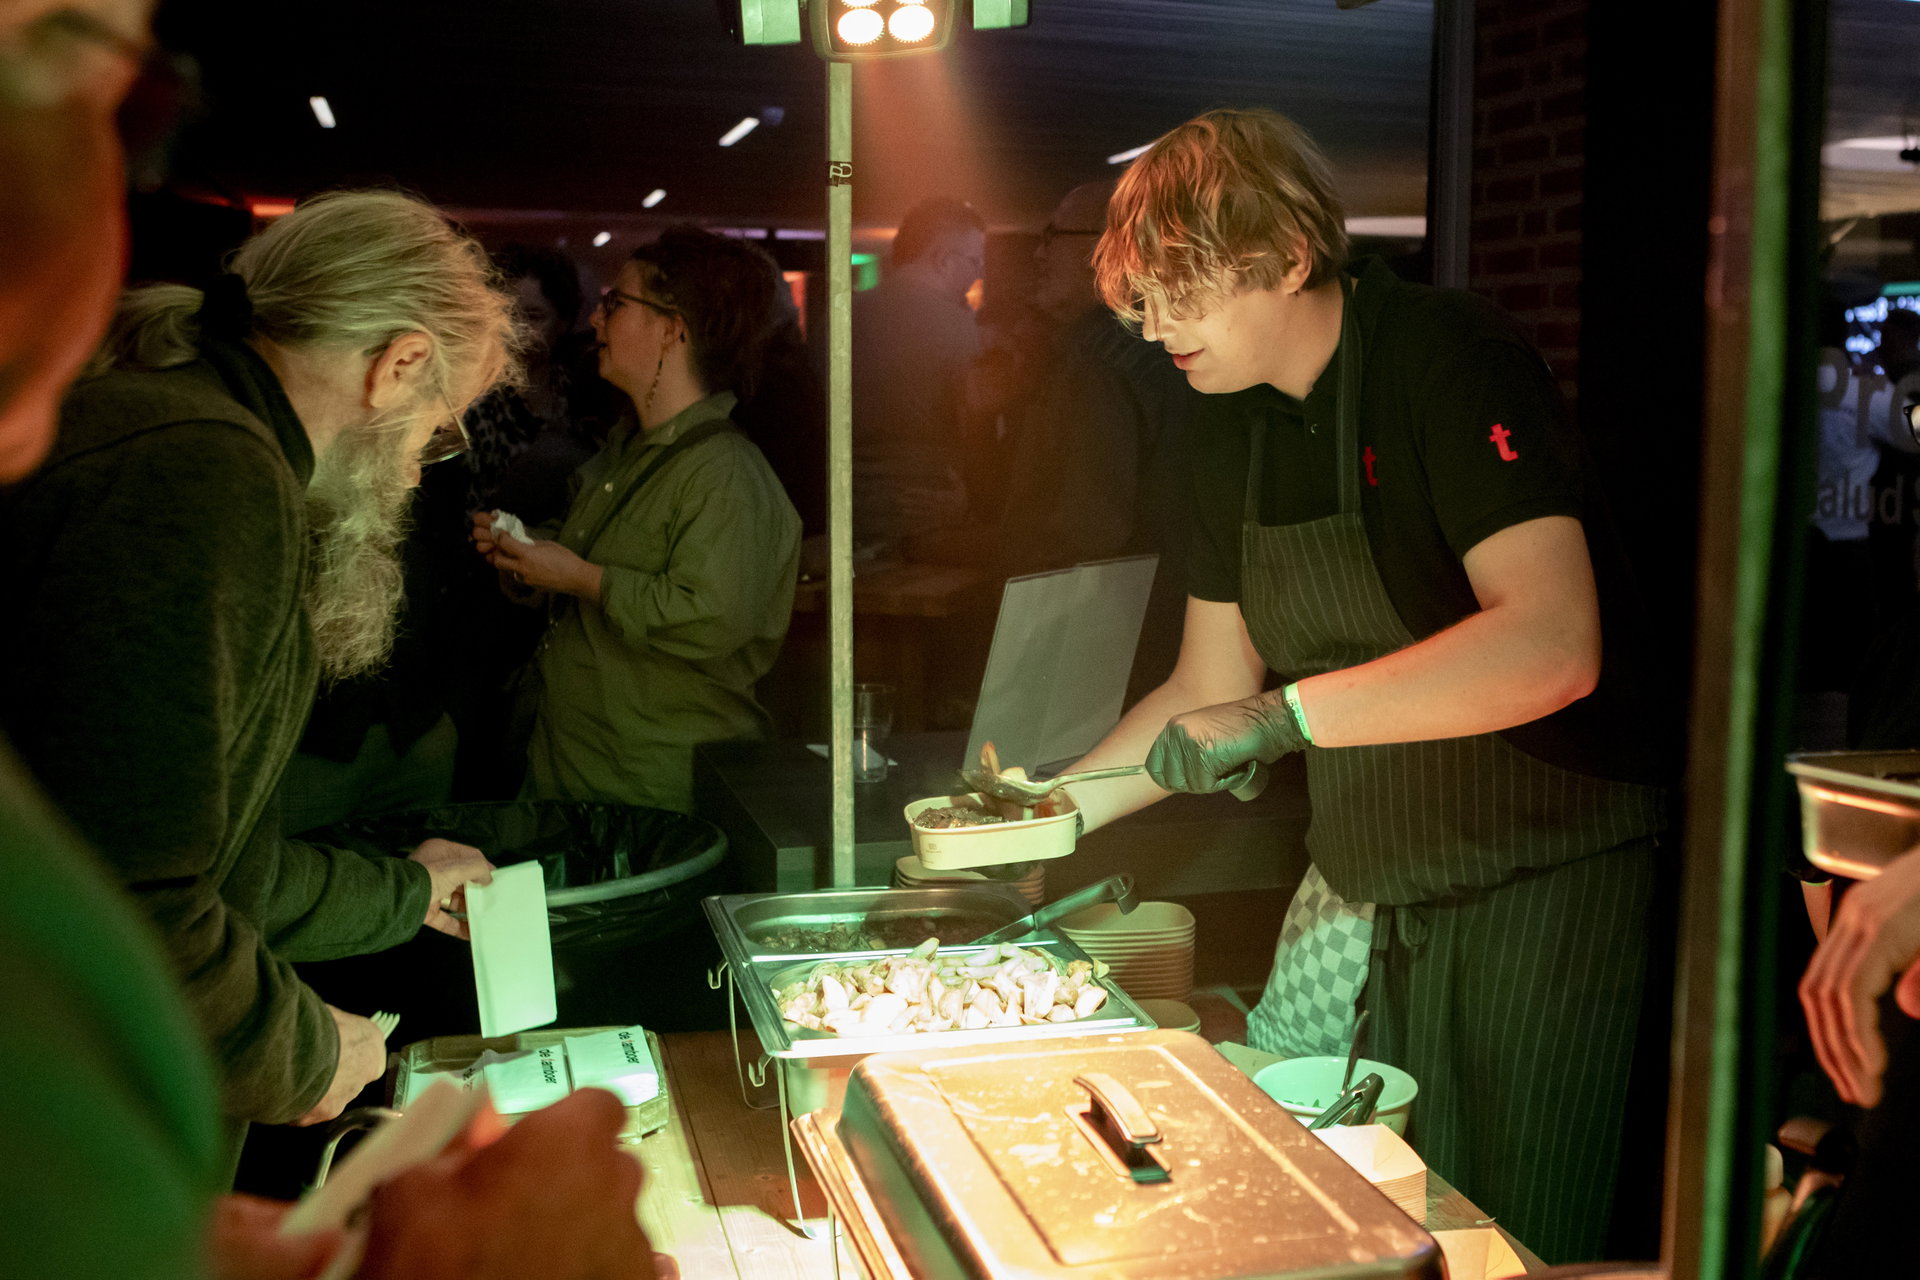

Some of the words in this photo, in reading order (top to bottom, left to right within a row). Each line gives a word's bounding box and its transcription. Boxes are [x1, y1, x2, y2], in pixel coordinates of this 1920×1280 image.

[1489, 423, 1519, 462] t
[1362, 446, 1378, 487] t
[618, 1031, 633, 1040] de
[539, 1049, 554, 1057] de
[621, 1040, 640, 1064] tamboer
[541, 1058, 558, 1084] tamboer
